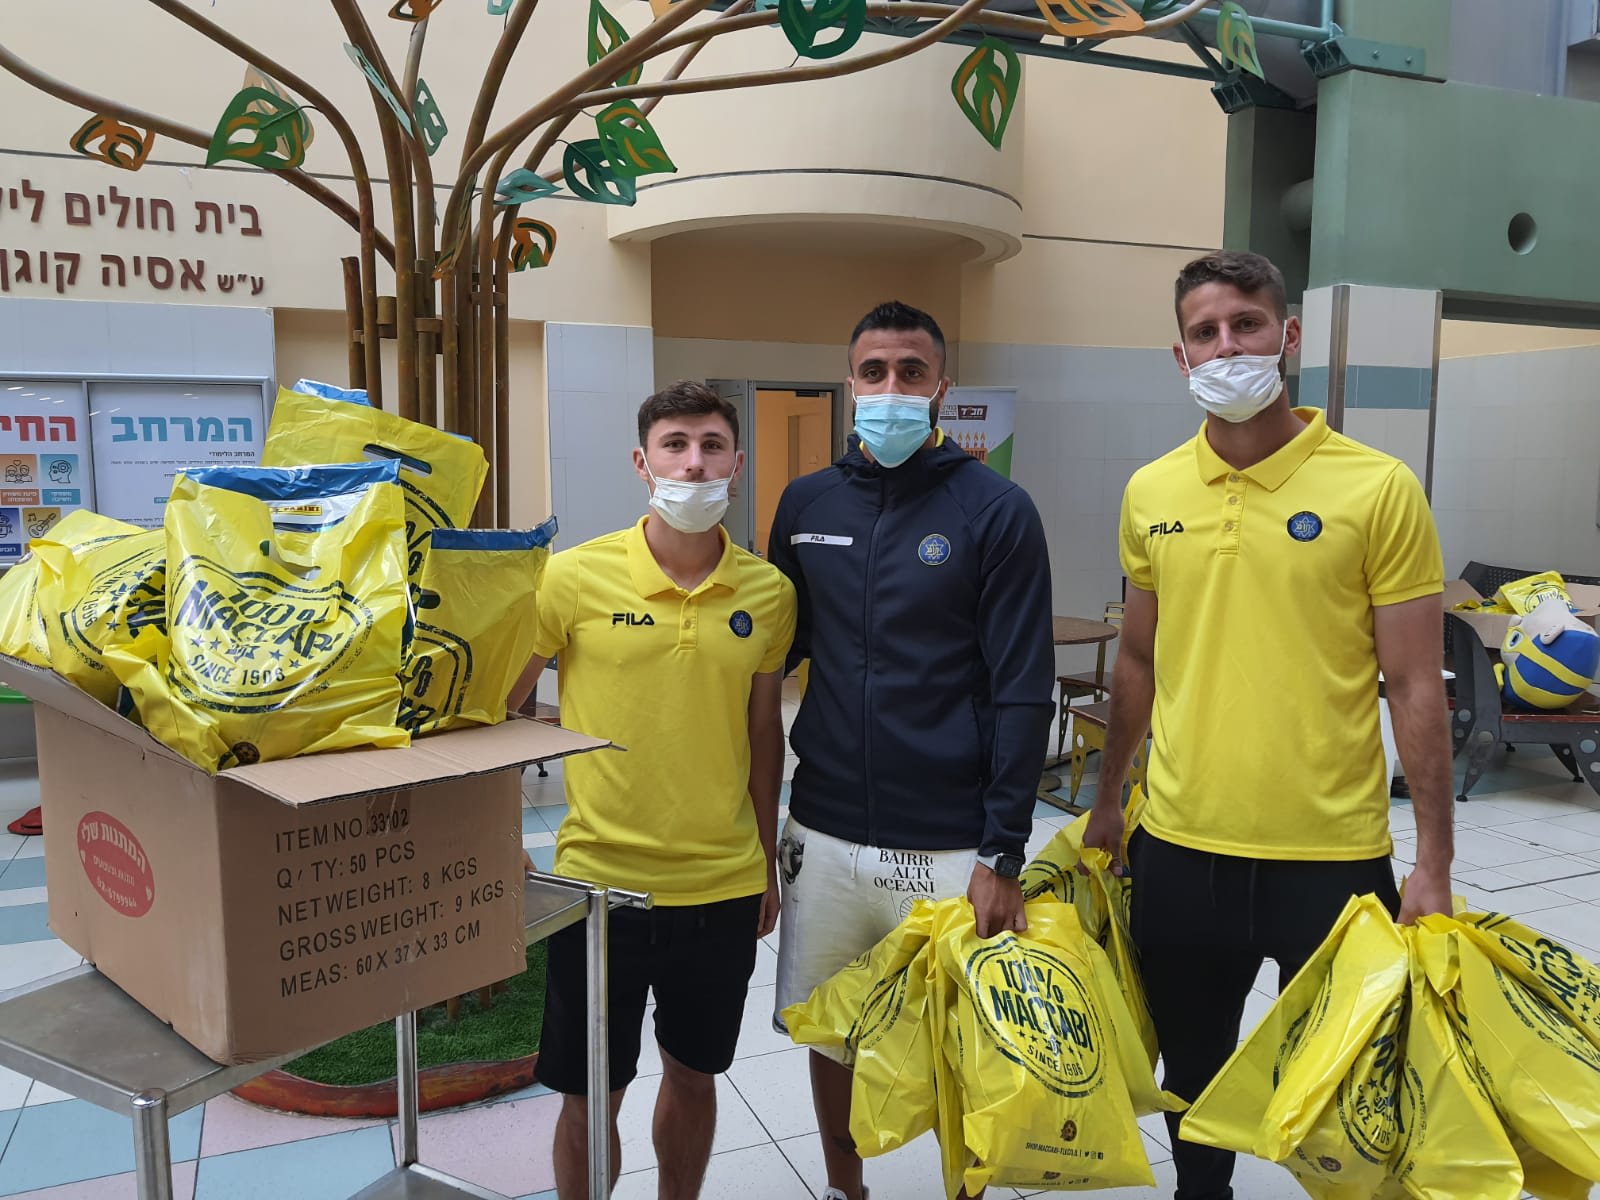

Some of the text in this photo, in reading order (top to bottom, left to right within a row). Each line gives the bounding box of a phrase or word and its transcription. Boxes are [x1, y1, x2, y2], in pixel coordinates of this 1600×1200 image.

[0, 179, 262, 237] בית חולים לי
[0, 249, 81, 294] קוגן
[101, 254, 206, 292] אסיה
[110, 416, 254, 442] המרחב
[810, 534, 825, 543] FILA
[1149, 520, 1185, 538] FILA
[612, 612, 655, 626] FILA
[188, 654, 286, 686] SINCE 1906
[350, 853, 367, 874] 50
[375, 840, 416, 868] PCS
[422, 871, 431, 890] 8
[441, 857, 478, 885] KGS
[879, 849, 934, 866] BAIRR
[455, 895, 463, 913] 9
[470, 879, 505, 908] KGS
[281, 919, 481, 998] MEAS: 60 X 37 X 33 CM
[989, 985, 1095, 1054] MACCABI
[1026, 1044, 1061, 1073] SINCE
